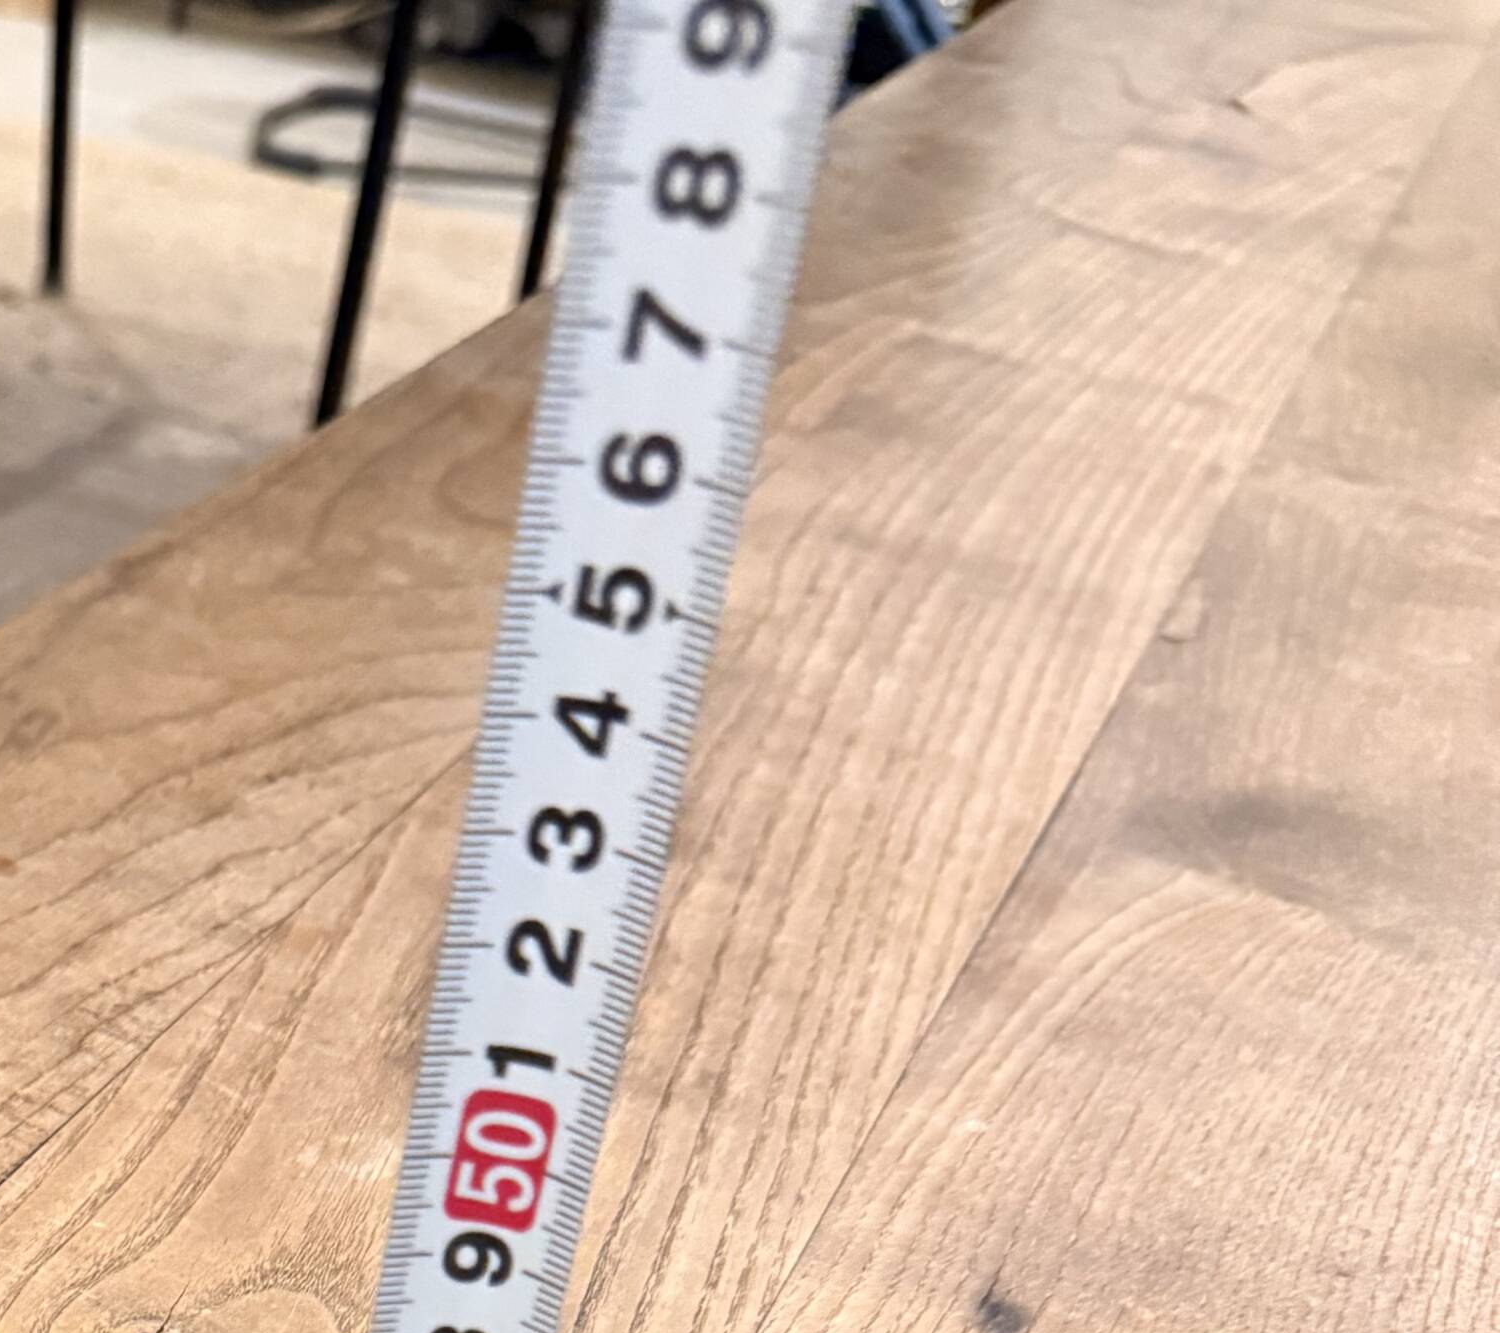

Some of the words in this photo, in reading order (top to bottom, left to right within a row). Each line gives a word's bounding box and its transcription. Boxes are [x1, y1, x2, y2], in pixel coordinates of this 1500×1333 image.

[683, 0, 774, 71] 9
[653, 147, 742, 228] 8
[622, 288, 707, 361] 7
[600, 434, 682, 504] 6
[573, 566, 654, 632] 5
[555, 692, 629, 757] 4
[527, 807, 604, 871] 3
[506, 920, 583, 986] 2
[486, 1045, 556, 1077] 1
[454, 1108, 548, 1212] 50
[443, 1231, 512, 1286] 9
